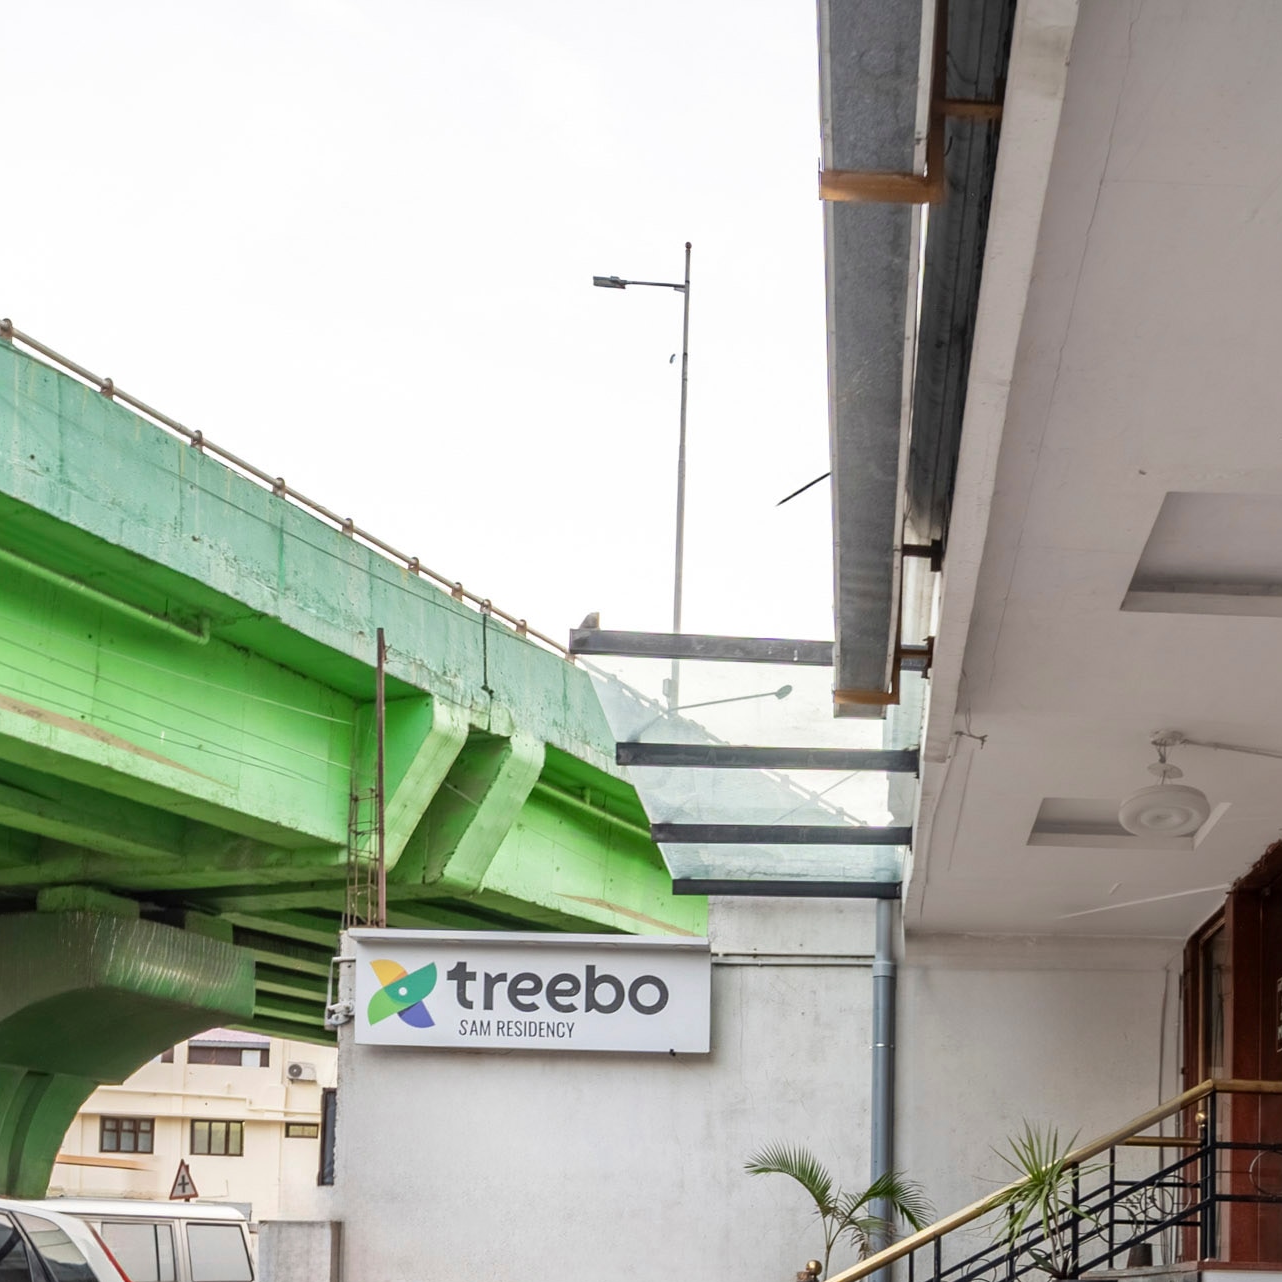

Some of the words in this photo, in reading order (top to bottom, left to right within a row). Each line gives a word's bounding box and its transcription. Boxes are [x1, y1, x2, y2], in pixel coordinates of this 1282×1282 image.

[446, 961, 669, 1015] treebo
[458, 1019, 491, 1036] SAM
[496, 1020, 575, 1038] RESIDENCY
